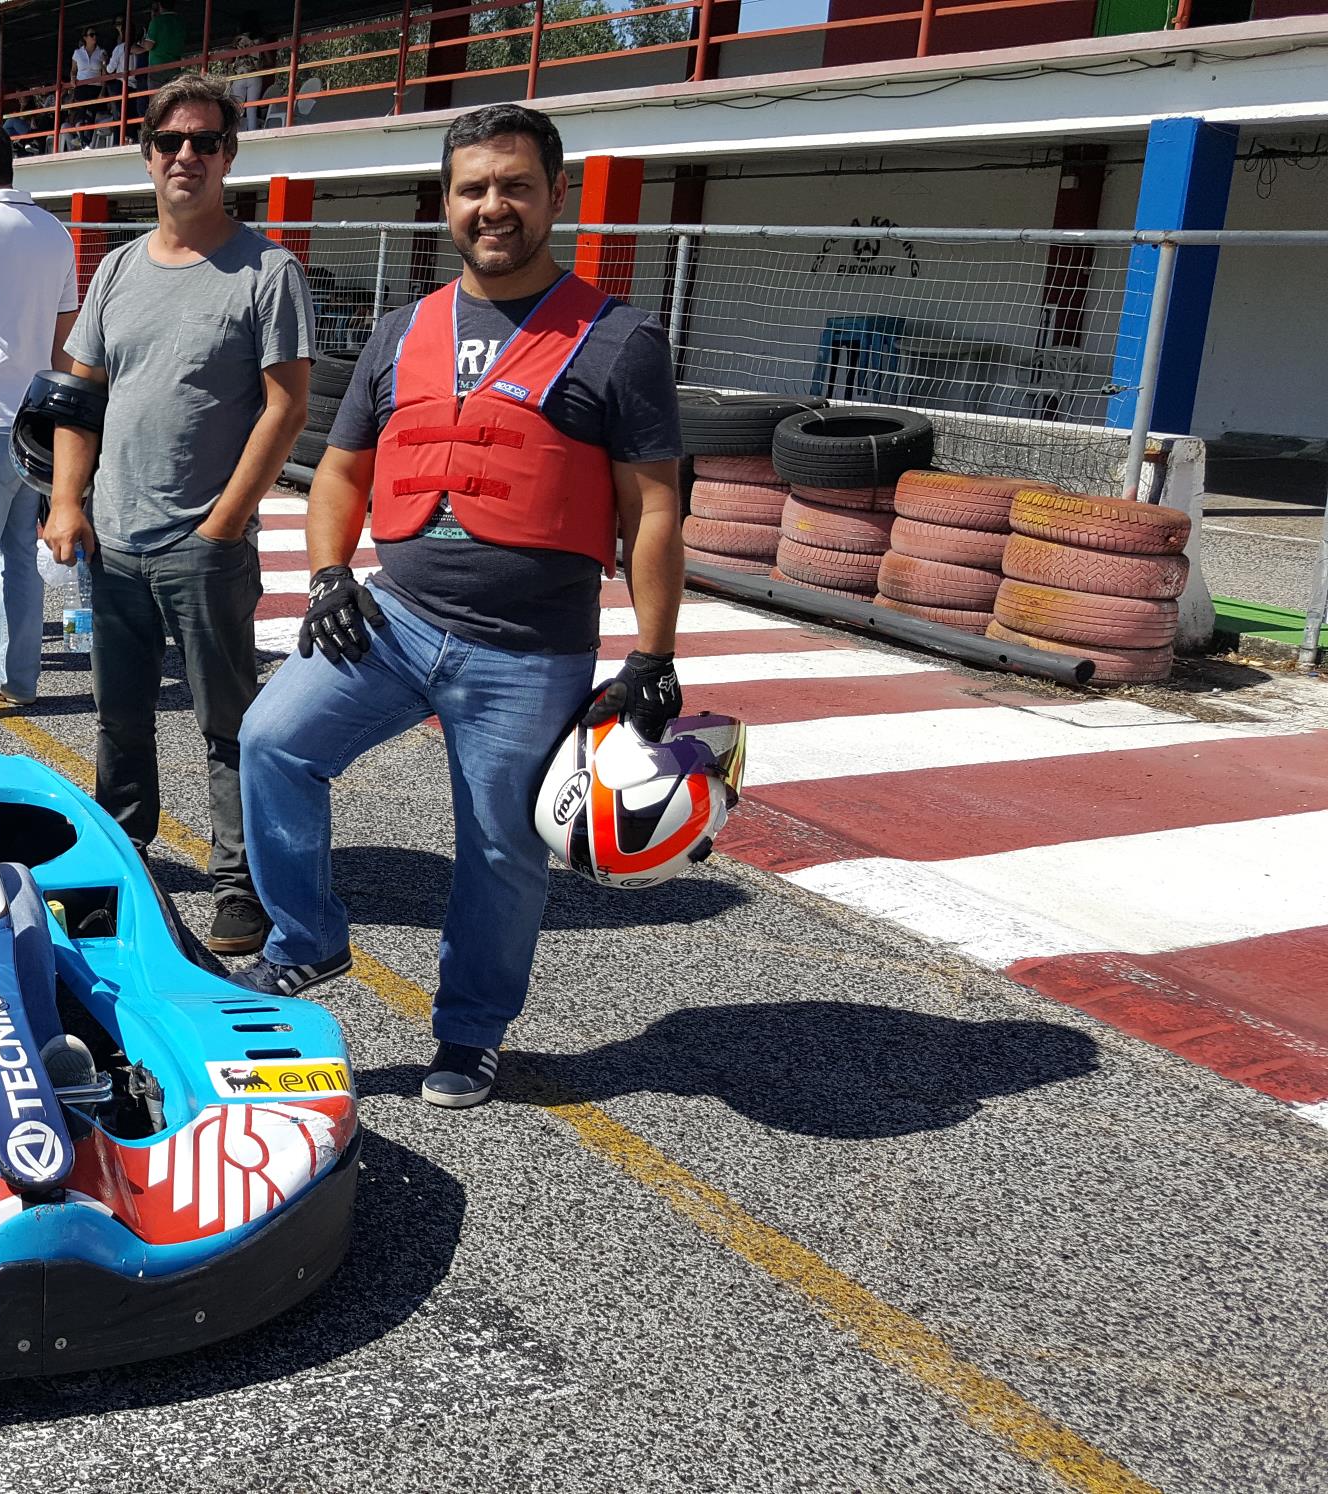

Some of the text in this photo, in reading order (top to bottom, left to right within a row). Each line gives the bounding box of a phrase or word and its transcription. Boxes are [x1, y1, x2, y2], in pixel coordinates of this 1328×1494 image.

[836, 264, 897, 277] EUROINDY
[492, 380, 527, 397] sparco
[557, 771, 585, 823] Arai
[278, 1062, 349, 1093] eni
